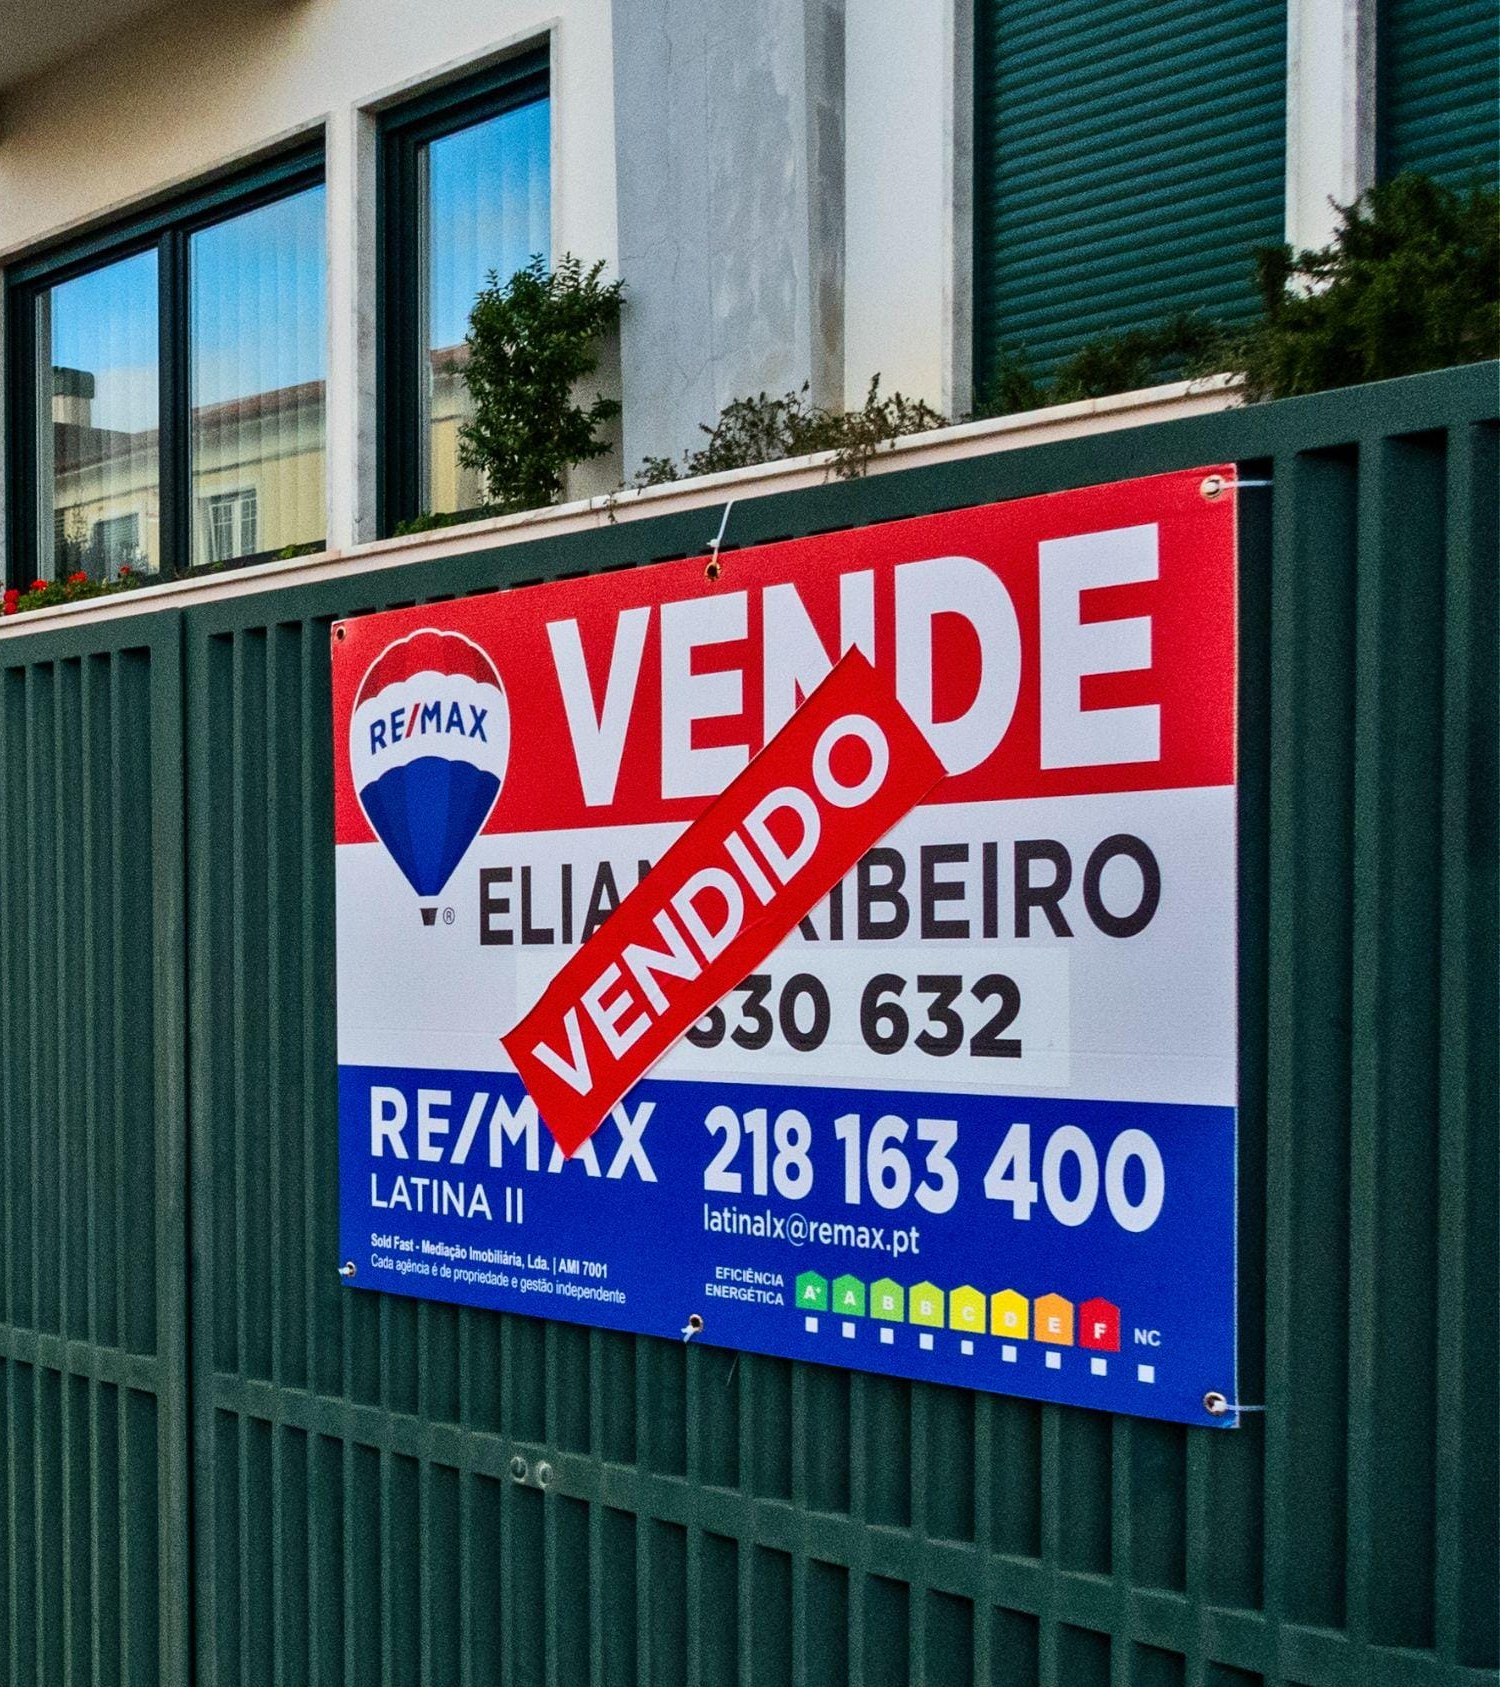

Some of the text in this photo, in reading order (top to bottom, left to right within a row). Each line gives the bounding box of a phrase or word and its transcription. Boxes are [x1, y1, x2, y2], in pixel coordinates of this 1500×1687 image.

[546, 522, 1161, 807] VENDE
[370, 701, 488, 755] RE/MAX
[480, 860, 653, 945] ELIA
[531, 714, 890, 1096] VENDIDO
[860, 973, 1022, 1059] 632
[704, 1105, 1165, 1233] 218 163 400
[371, 1172, 523, 1224] LATINA II
[371, 1232, 392, 1248] Sold
[393, 1235, 414, 1252] Fast
[421, 1240, 467, 1261] Mediação
[469, 1246, 525, 1270] Imobiliária,
[527, 1254, 550, 1271] Lda.
[558, 1258, 580, 1275] AMI
[582, 1261, 607, 1279] 7001
[704, 1203, 920, 1258] latinalx@remax.pt
[371, 1252, 626, 1304] Cada agência é de propriedade e gestão independente
[705, 1284, 785, 1306] ENERGÉTICA
[715, 1266, 784, 1287] EFICIÊNCIA
[843, 1290, 857, 1306] A
[882, 1295, 894, 1311] B
[962, 1306, 975, 1322] C
[1004, 1311, 1017, 1328] D
[1048, 1316, 1061, 1334] E
[1094, 1322, 1106, 1340] F
[1134, 1328, 1161, 1347] NC
